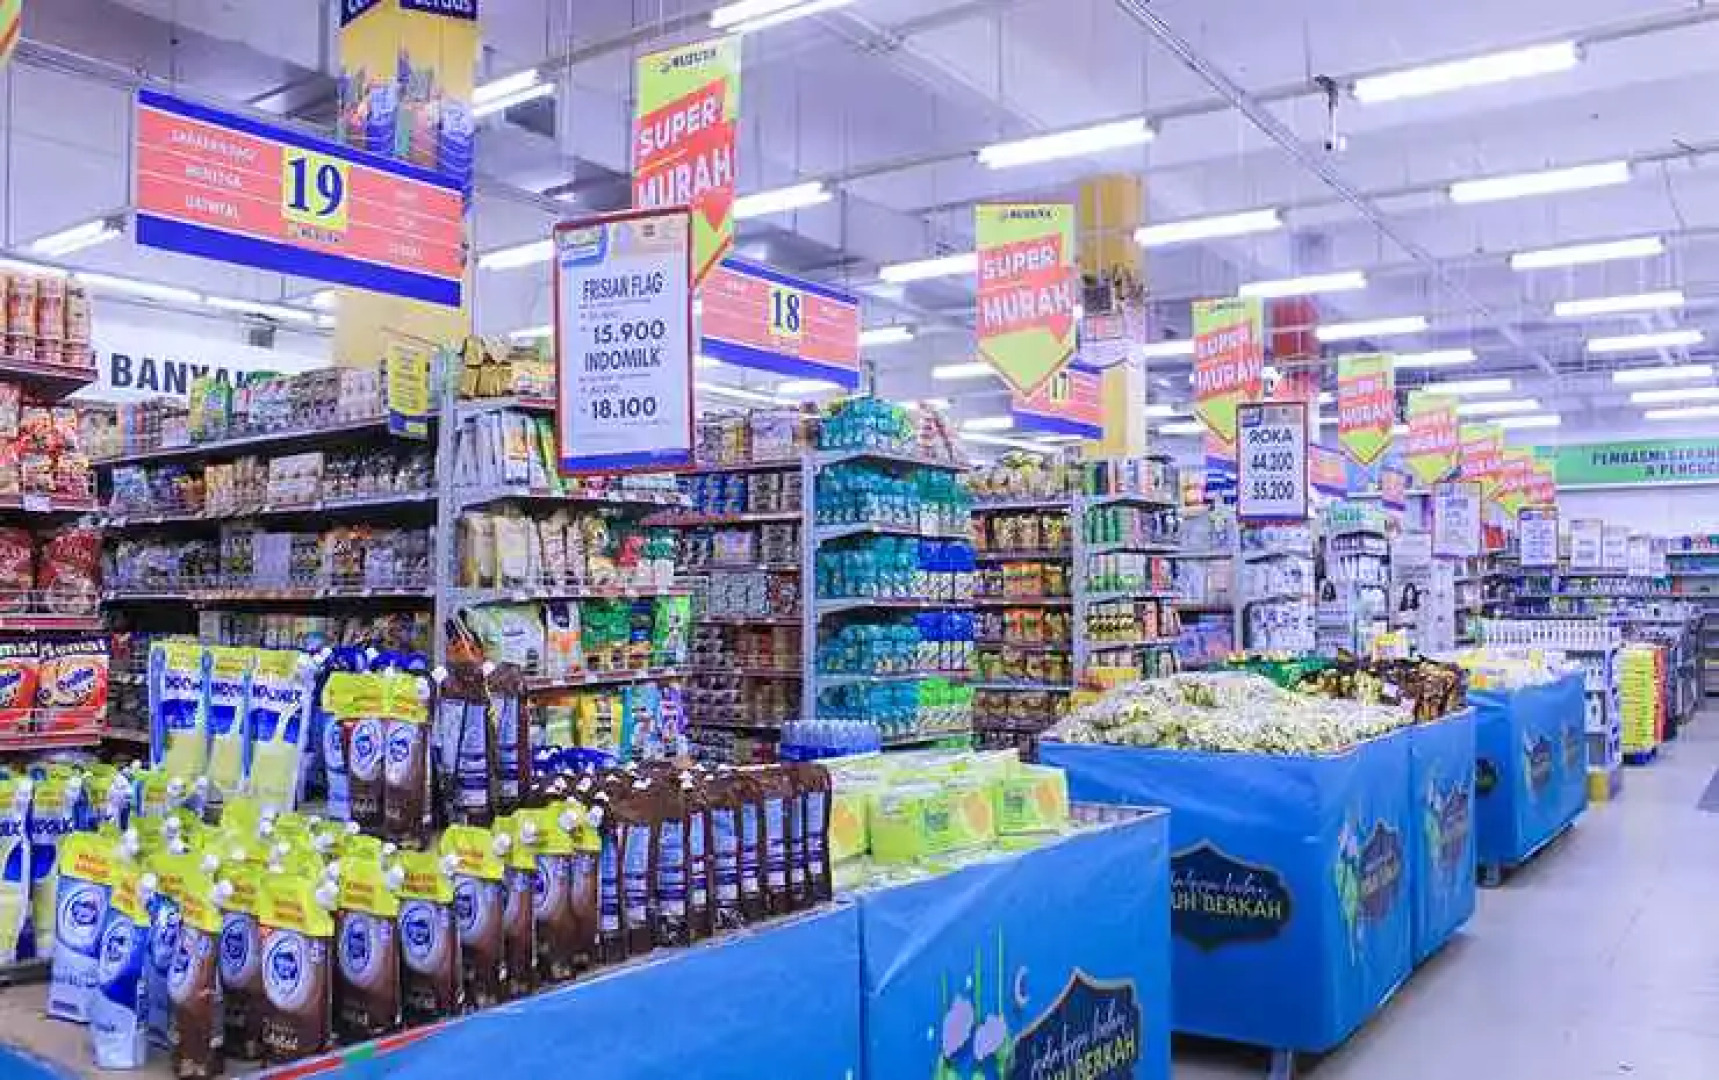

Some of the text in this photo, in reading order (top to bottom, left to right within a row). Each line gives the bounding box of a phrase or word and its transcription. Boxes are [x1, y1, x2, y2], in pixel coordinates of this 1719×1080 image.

[639, 96, 715, 157] SUPER
[287, 156, 343, 217] 19
[637, 143, 732, 208] MURAH
[984, 245, 1056, 280] SUPER
[631, 271, 663, 298] FLAG
[773, 289, 800, 333] 18
[984, 280, 1073, 327] MURAH
[593, 318, 666, 346] 15.900
[584, 346, 662, 373] INDOMILK
[591, 396, 656, 420] 18.100
[1203, 892, 1281, 920] BERKAH
